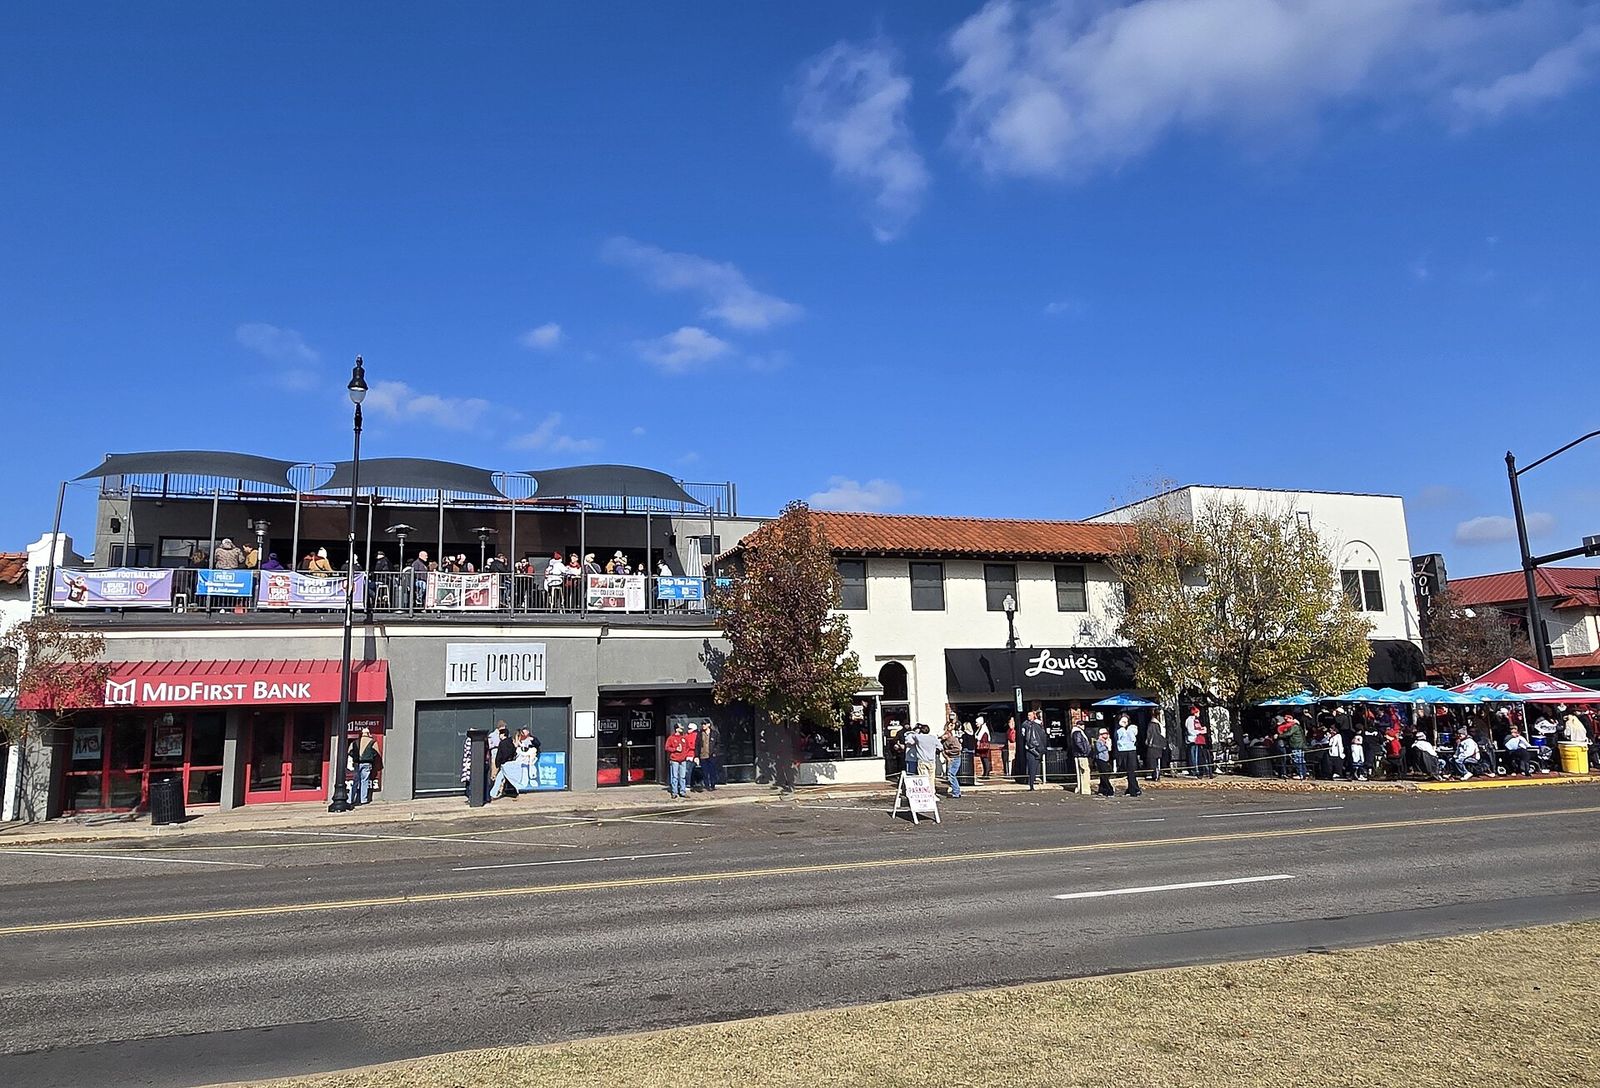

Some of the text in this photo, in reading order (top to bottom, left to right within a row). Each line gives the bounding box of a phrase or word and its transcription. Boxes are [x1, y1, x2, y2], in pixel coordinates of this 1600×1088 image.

[118, 571, 149, 579] FOOTBALL
[303, 579, 328, 587] BUD
[299, 586, 332, 594] LIGHT
[1024, 649, 1098, 677] Louie's
[449, 653, 543, 682] THE PORCH
[1079, 669, 1106, 682] TOO
[912, 779, 923, 787] NO
